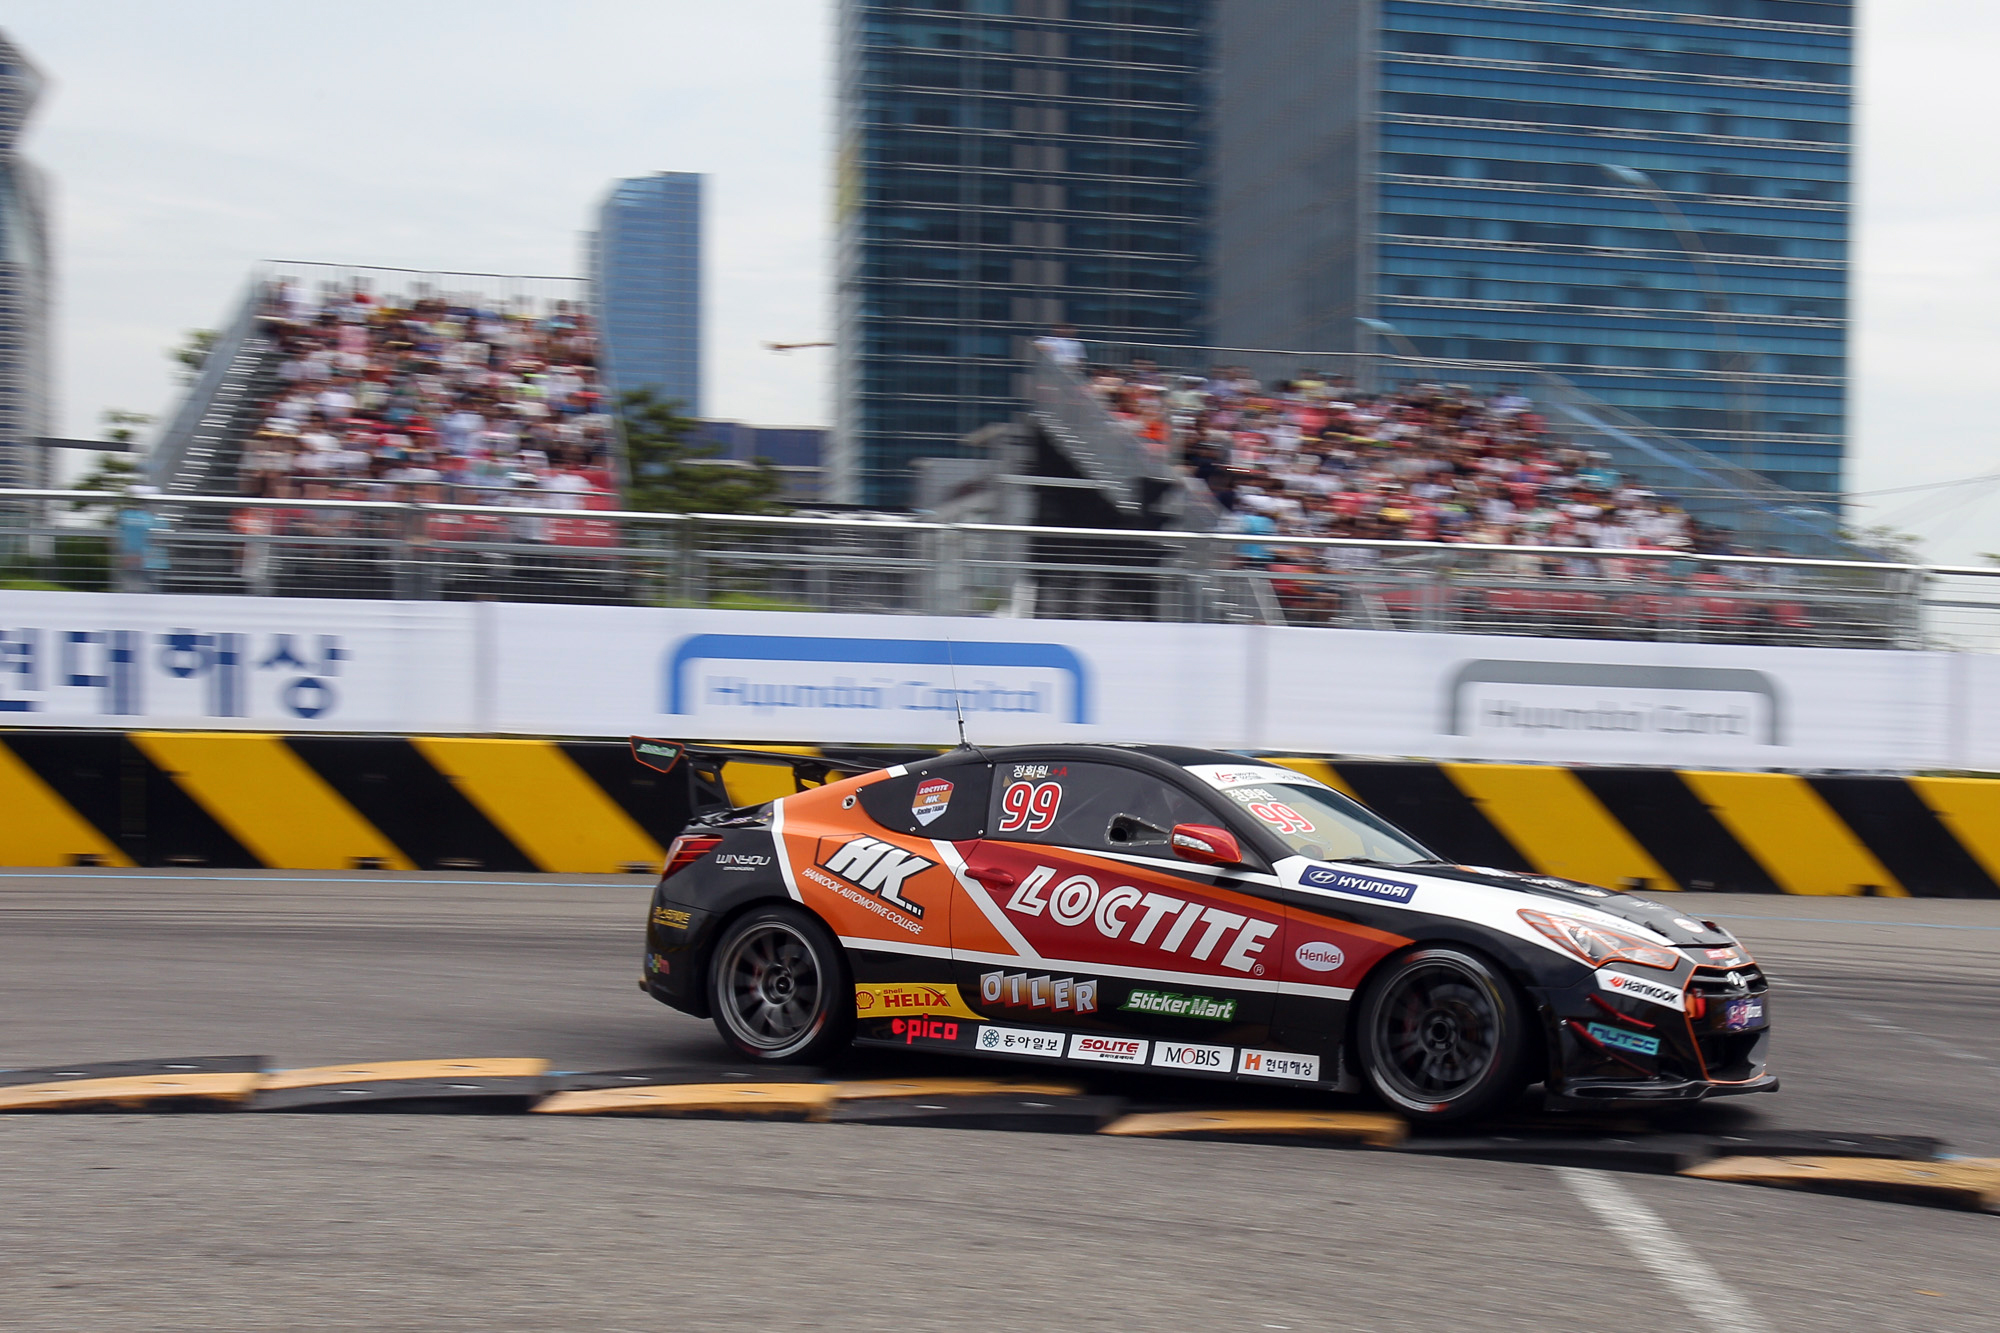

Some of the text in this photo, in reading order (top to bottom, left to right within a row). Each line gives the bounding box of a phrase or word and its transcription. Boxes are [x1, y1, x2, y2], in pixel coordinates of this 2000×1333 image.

[704, 675, 893, 716] Hyundai
[1480, 700, 1652, 737] Hyundai
[1013, 765, 1049, 779] 정회원
[919, 784, 949, 794] LOCTITE
[999, 781, 1063, 833] 99
[1247, 801, 1316, 835] 99
[1336, 875, 1411, 899] HYUNDAI
[802, 867, 924, 936] HANKOOK AUTOMOTIVE COLLEGE
[1005, 864, 1280, 974] LOCTITE
[1299, 947, 1342, 965] Henkel
[883, 993, 950, 1008] HELIX
[982, 973, 1095, 1013] OILER
[1128, 991, 1235, 1019] Sticker Mart
[1003, 1033, 1058, 1052] 동아일보
[1079, 1038, 1140, 1053] SOLITE
[1164, 1046, 1221, 1067] MOBIS
[1265, 1058, 1314, 1076] 현대해상
